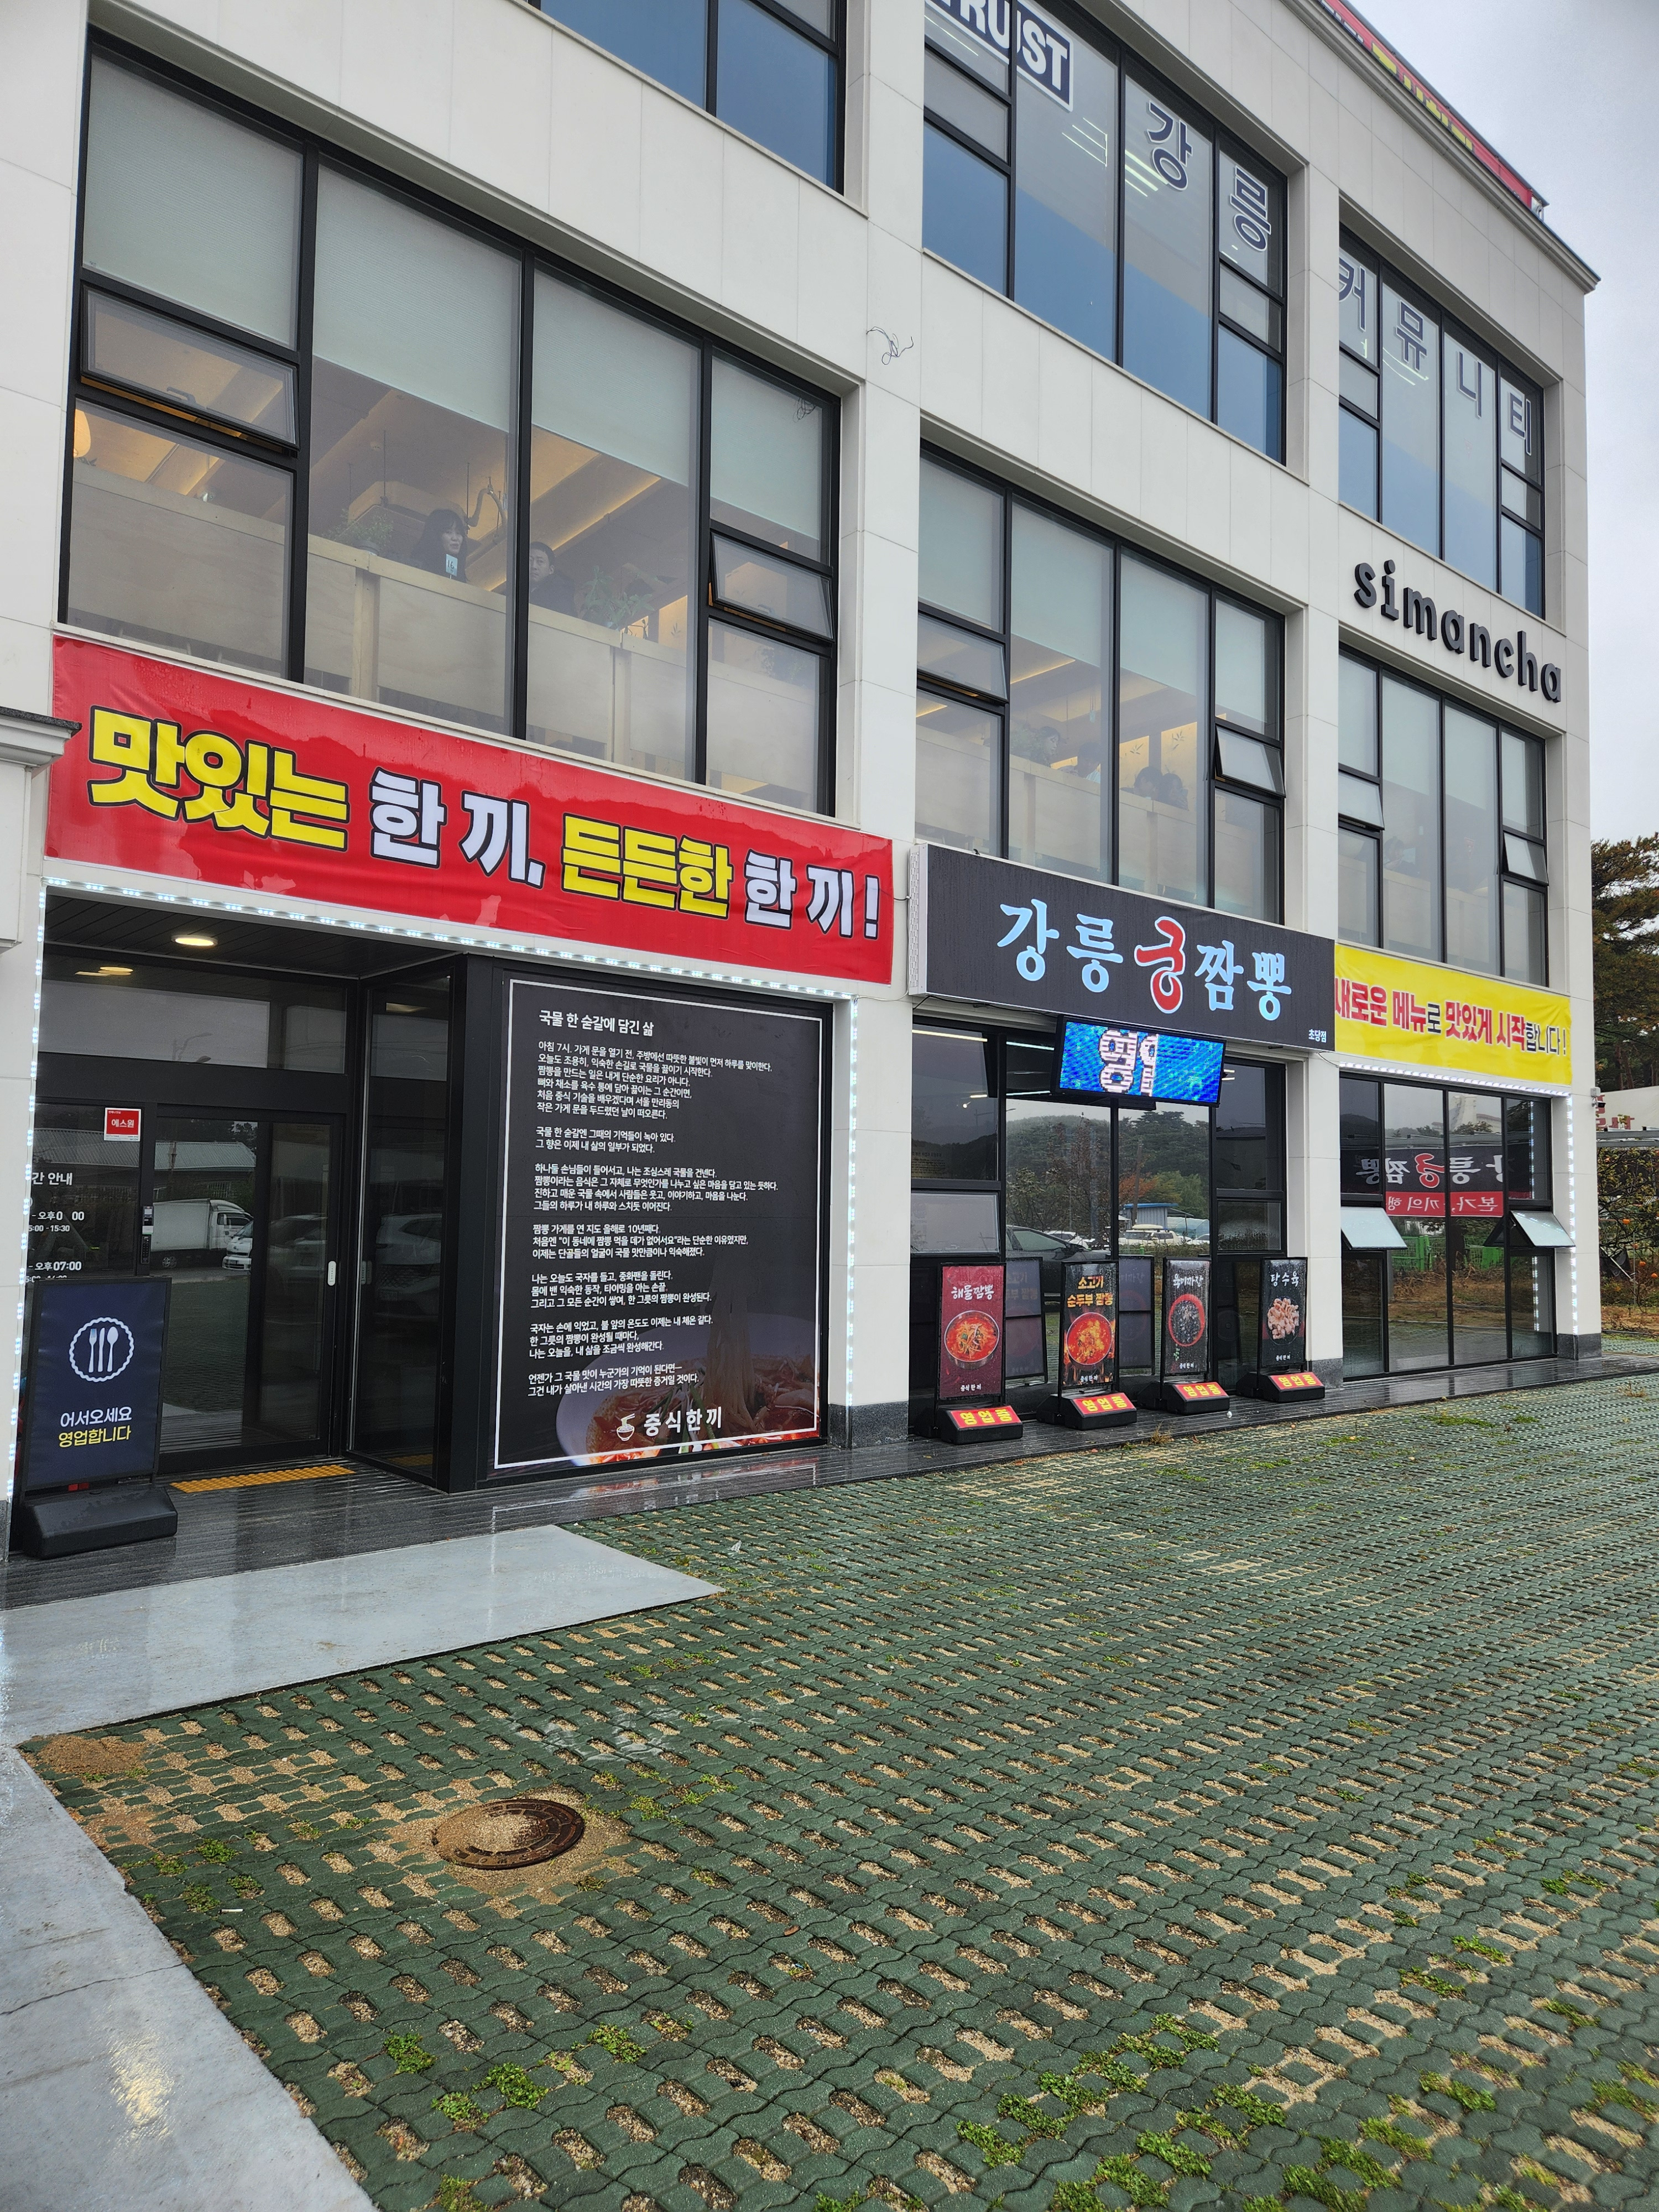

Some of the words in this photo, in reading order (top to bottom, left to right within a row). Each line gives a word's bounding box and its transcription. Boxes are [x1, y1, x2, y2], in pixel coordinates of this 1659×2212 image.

[943, 0, 1067, 91] RUST
[1146, 100, 1271, 252] 강릉
[1339, 257, 1531, 456] 커뮤니티
[1354, 559, 1561, 703] simancha
[86, 705, 349, 852] 맛있는
[369, 766, 446, 868] 한
[562, 813, 734, 919] 든든한
[744, 848, 798, 930] 한
[806, 863, 880, 940] 끼!
[539, 1009, 564, 1027] 국물
[566, 1012, 578, 1029] 한
[581, 1014, 615, 1032] 숟갈에
[618, 1018, 639, 1035] 담긴
[642, 1020, 654, 1036] 삶
[1335, 977, 1387, 1027] 새로운
[1392, 990, 1442, 1035] 메뉴로
[1444, 1000, 1493, 1045] 맛있게
[1496, 1011, 1567, 1056] 시작합니다!
[1308, 1029, 1327, 1043] 초당점
[538, 1040, 554, 1052] 아침
[574, 1044, 589, 1055] 가게
[591, 1045, 607, 1057] 문을
[608, 1047, 623, 1058] 열기
[636, 1050, 664, 1062] 주방에선
[666, 1052, 687, 1064] 따뜻한
[688, 1055, 708, 1066] 불빛이
[709, 1057, 723, 1067] 먼저
[724, 1058, 744, 1070] 하루를
[538, 1053, 562, 1065] 오늘도
[591, 1057, 614, 1069] 익숙한
[615, 1060, 637, 1071] 손길로
[638, 1062, 660, 1073] 국물을
[661, 1063, 682, 1075] 끓이기
[537, 1065, 562, 1077] 짬뽕을
[563, 1067, 587, 1079] 만드는
[588, 1069, 604, 1080] 일은
[605, 1070, 620, 1081] 내게
[622, 1072, 644, 1083] 단순한
[645, 1073, 666, 1085] 요리가
[537, 1089, 554, 1100] 처음
[555, 1091, 570, 1102] 중식
[572, 1092, 596, 1103] 기술을
[597, 1093, 633, 1105] 배우겠다며
[635, 1096, 650, 1107] 서울
[651, 1097, 679, 1109] 만리동의
[536, 1102, 553, 1113] 작은
[555, 1103, 571, 1114] 가게
[572, 1104, 588, 1115] 문을
[588, 1105, 619, 1117] 두드렸던
[620, 1107, 635, 1118] 날이
[111, 1119, 134, 1128] 에스원
[535, 1126, 552, 1137] 국물
[554, 1126, 562, 1138] 한
[563, 1127, 587, 1139] 숟갈엔
[588, 1128, 611, 1140] 그때의
[613, 1130, 641, 1141] 기억들이
[643, 1131, 658, 1142] 녹아
[534, 1162, 559, 1174] 하나둘
[560, 1164, 591, 1175] 손님들이
[627, 1166, 641, 1176] 나는
[643, 1166, 671, 1177] 조심스레
[672, 1167, 693, 1177] 국물을
[48, 1172, 73, 1186] 안내
[534, 1175, 574, 1187] 짬뽕이라는
[575, 1176, 599, 1187] 음식은
[599, 1177, 608, 1186] 그
[609, 1177, 632, 1187] 자체로
[633, 1178, 669, 1188] 무엇인가를
[670, 1178, 691, 1189] 나누고
[692, 1179, 706, 1189] 싶은
[707, 1180, 728, 1190] 마음을
[728, 1180, 742, 1190] 담고
[743, 1180, 757, 1190] 있는
[533, 1200, 557, 1211] 그들의
[559, 1200, 583, 1211] 하루가
[585, 1201, 592, 1211] 내
[594, 1201, 617, 1211] 하루와
[618, 1201, 640, 1211] 스치듯
[532, 1224, 549, 1234] 짬뽕
[551, 1224, 575, 1234] 가게를
[576, 1224, 584, 1234] 연
[586, 1224, 601, 1234] 지도
[602, 1224, 625, 1234] 올해로
[531, 1273, 548, 1284] 나는
[549, 1272, 573, 1284] 오늘도
[575, 1272, 598, 1282] 국자를
[618, 1270, 648, 1281] 중화팬을
[1078, 1275, 1104, 1290] 소고기
[1270, 1271, 1299, 1287] 탕수육
[951, 1284, 994, 1300] 해물짬뽕
[1067, 1293, 1093, 1308] 순두부
[1095, 1292, 1113, 1306] 짬뽕
[529, 1348, 546, 1359] 나는
[575, 1345, 583, 1356] 내
[585, 1344, 601, 1356] 삶을
[602, 1343, 625, 1354] 조금씩
[528, 1385, 544, 1397] 그건
[546, 1384, 562, 1396] 내가
[564, 1381, 587, 1394] 살아낸
[589, 1380, 612, 1392] 시간의
[613, 1378, 629, 1390] 가장
[630, 1376, 653, 1389] 따뜻한
[653, 1375, 675, 1386] 증거일
[1278, 1374, 1316, 1387] 영업중
[1183, 1384, 1221, 1397] 영업중
[1082, 1396, 1127, 1412] 영업중
[60, 1406, 132, 1427] 어서오세요
[644, 1406, 722, 1437] 중식한끼
[960, 1408, 1013, 1426] 영업중
[59, 1425, 132, 1448] 영업합니다
